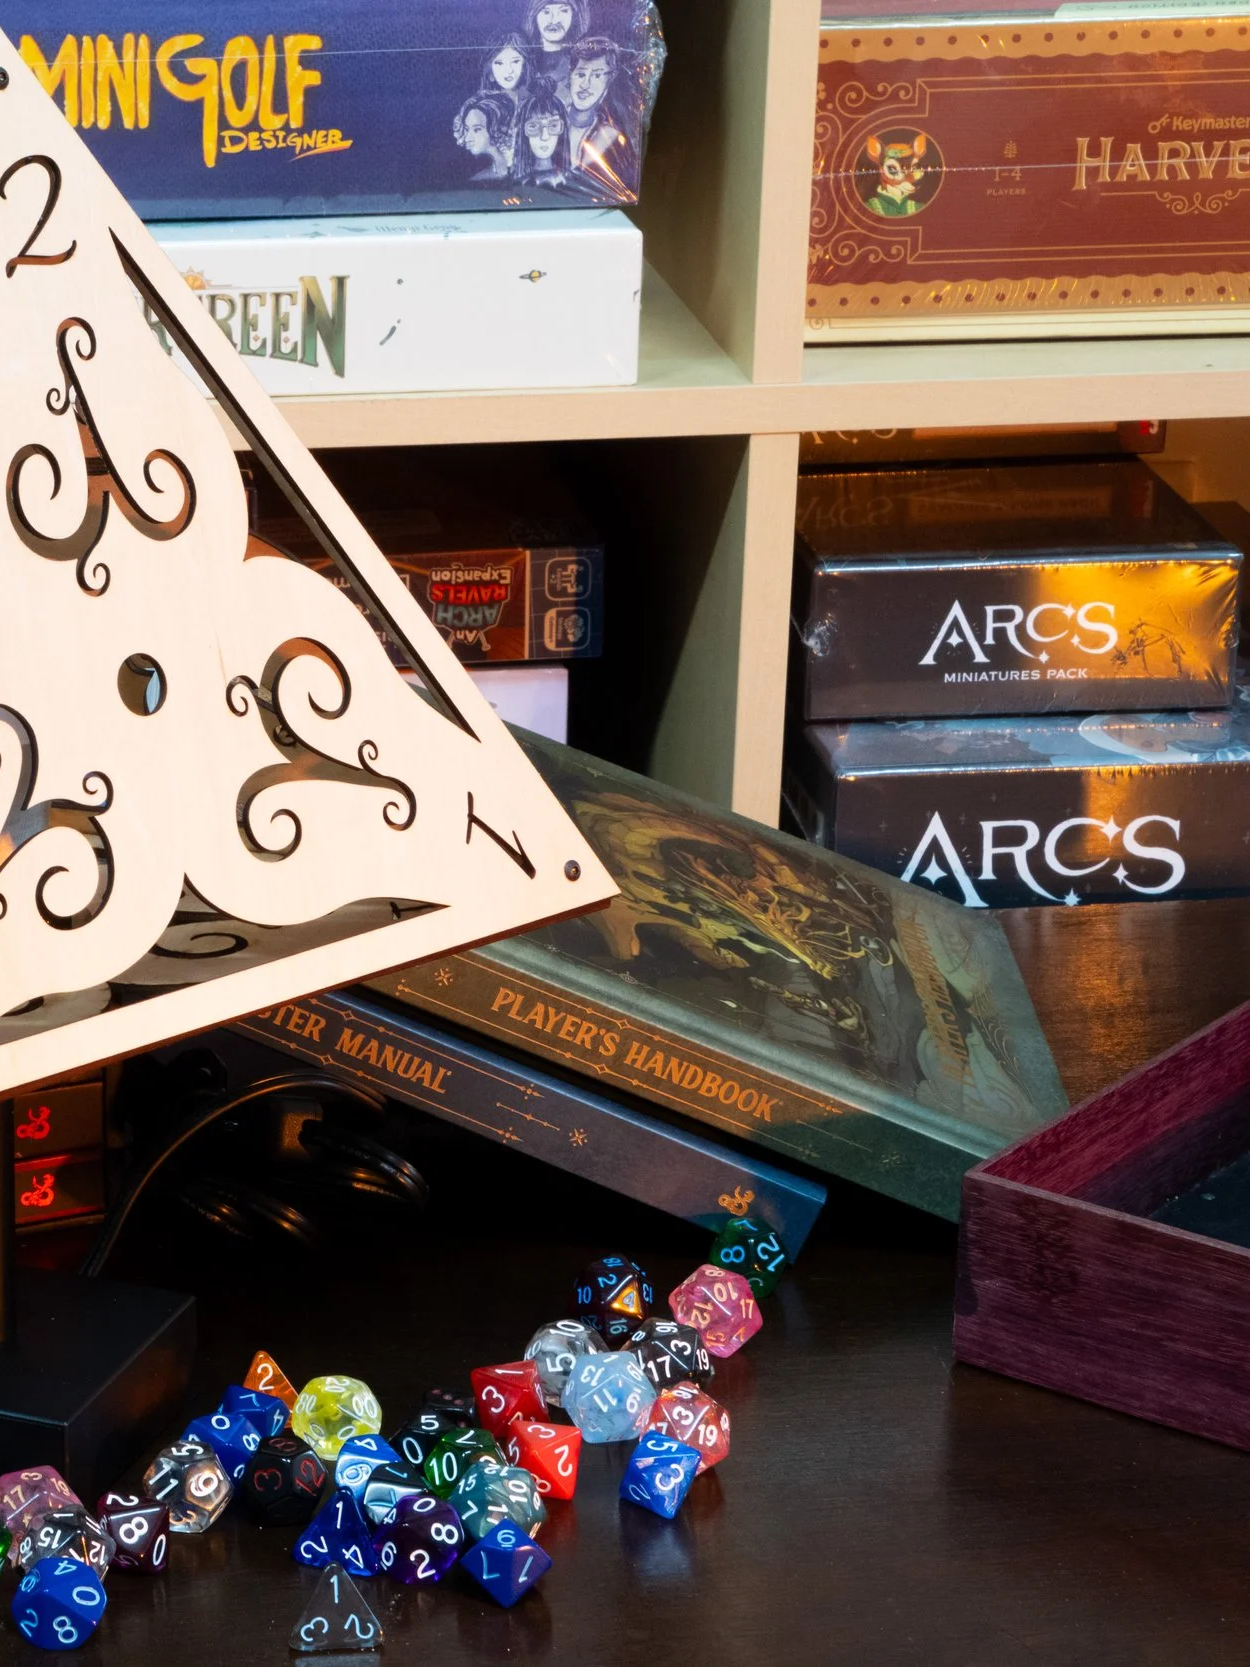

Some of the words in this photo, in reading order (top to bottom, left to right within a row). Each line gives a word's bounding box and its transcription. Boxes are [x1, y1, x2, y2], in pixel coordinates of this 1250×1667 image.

[19, 32, 150, 129] MINI
[156, 33, 322, 168] GOLF
[220, 130, 352, 154] DESIGNER
[986, 187, 1027, 197] PLAYERS
[431, 568, 512, 584] Expansion
[432, 584, 509, 604] RAVELS
[436, 604, 499, 627] ARCH
[456, 630, 478, 643] An
[918, 599, 1119, 665] ARCS
[943, 669, 1041, 684] MINIATURES
[1046, 667, 1088, 680] PACK
[900, 811, 1186, 909] ARCS
[334, 1027, 452, 1095] MANUAL
[490, 986, 618, 1058] PLAYER'S
[624, 1041, 783, 1123] HANDBOOK
[720, 1245, 746, 1264] 8
[757, 1235, 785, 1272] 12
[597, 1273, 617, 1287] 2
[713, 1282, 738, 1301] 10
[577, 1286, 592, 1304] 10
[739, 1298, 754, 1320] 17
[549, 1319, 585, 1337] 10
[671, 1339, 692, 1356] 3
[547, 1353, 578, 1373] 5
[647, 1355, 672, 1382] 17
[696, 1349, 710, 1371] 19
[256, 1363, 274, 1391] 2
[580, 1364, 606, 1387] 13
[481, 1385, 505, 1414] 3
[211, 1415, 230, 1430] 0
[271, 1408, 283, 1437] 4
[420, 1415, 440, 1431] 5
[672, 1405, 694, 1425] 3
[527, 1424, 556, 1439] 3
[697, 1423, 718, 1446] 19
[354, 1438, 378, 1451] 4
[402, 1436, 424, 1464] 0
[429, 1452, 458, 1486] 10
[554, 1445, 573, 1477] 2
[253, 1469, 283, 1492] 3
[295, 1459, 324, 1496] 12
[458, 1473, 477, 1494] 15
[654, 1463, 685, 1491] 3
[2, 1484, 26, 1511] 17
[106, 1493, 139, 1507] 2
[508, 1479, 528, 1504] 10
[335, 1500, 344, 1529] 1
[412, 1497, 436, 1513] 0
[461, 1500, 479, 1521] 7
[37, 1526, 62, 1549] 15
[118, 1516, 149, 1544] 8
[430, 1522, 459, 1544] 8
[152, 1534, 166, 1566] 0
[300, 1536, 329, 1559] 2
[342, 1545, 364, 1569] 4
[54, 1560, 77, 1576] 4
[409, 1549, 436, 1579] 2
[72, 1586, 100, 1606] 0
[329, 1574, 339, 1604] 1
[20, 1608, 39, 1637] 2
[52, 1615, 78, 1644] 8
[300, 1616, 329, 1642] 3
[344, 1614, 375, 1640] 2
